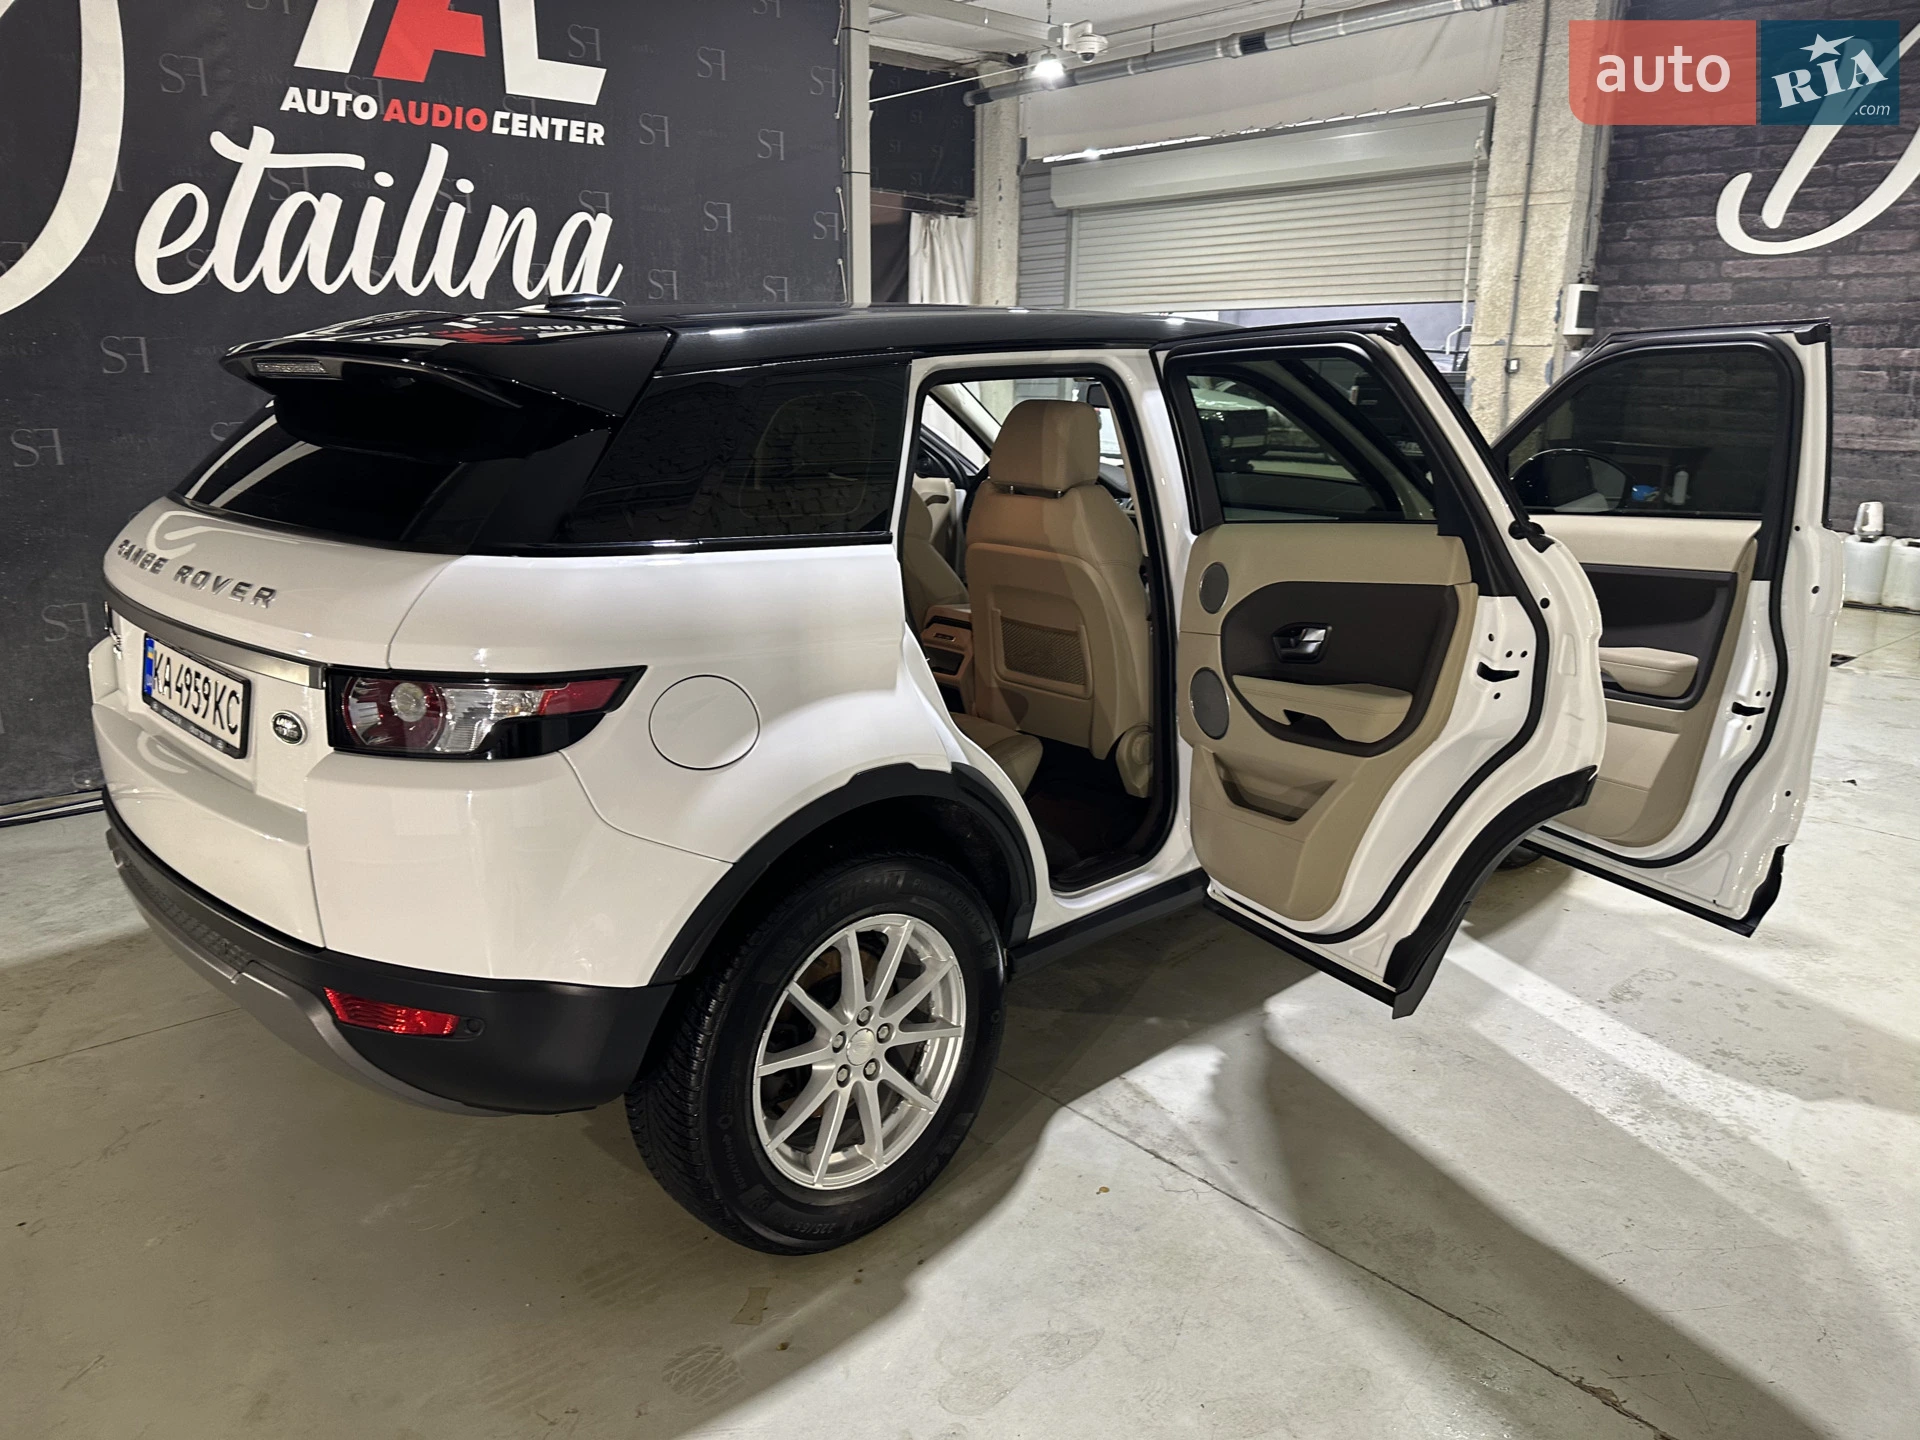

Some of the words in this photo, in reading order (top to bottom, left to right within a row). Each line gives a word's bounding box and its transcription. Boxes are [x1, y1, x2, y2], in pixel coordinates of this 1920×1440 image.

[280, 86, 379, 121] AUTO
[383, 98, 488, 132] AUDIO
[491, 110, 606, 146] CENTER
[117, 538, 169, 575] RANGE
[172, 564, 278, 609] ROVER
